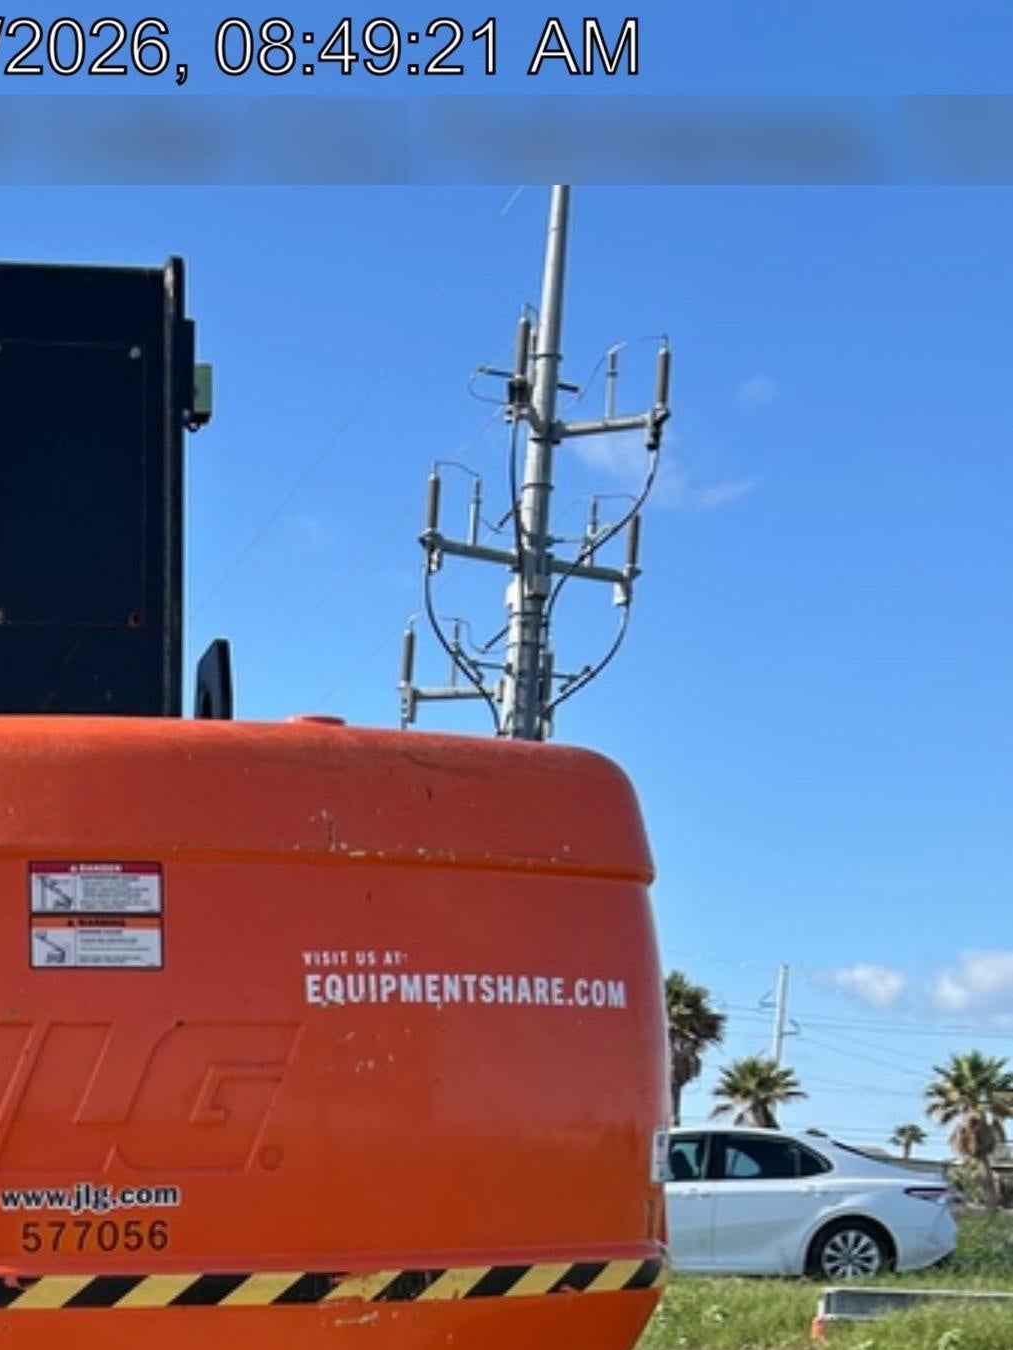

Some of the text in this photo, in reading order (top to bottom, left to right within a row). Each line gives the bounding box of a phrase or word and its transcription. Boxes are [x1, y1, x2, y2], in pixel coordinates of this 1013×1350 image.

[302, 950, 349, 966] VISIT
[355, 950, 377, 966] US
[304, 973, 627, 1008] EQUIPMENTSHARE.COM
[21, 1220, 170, 1252] 577056
